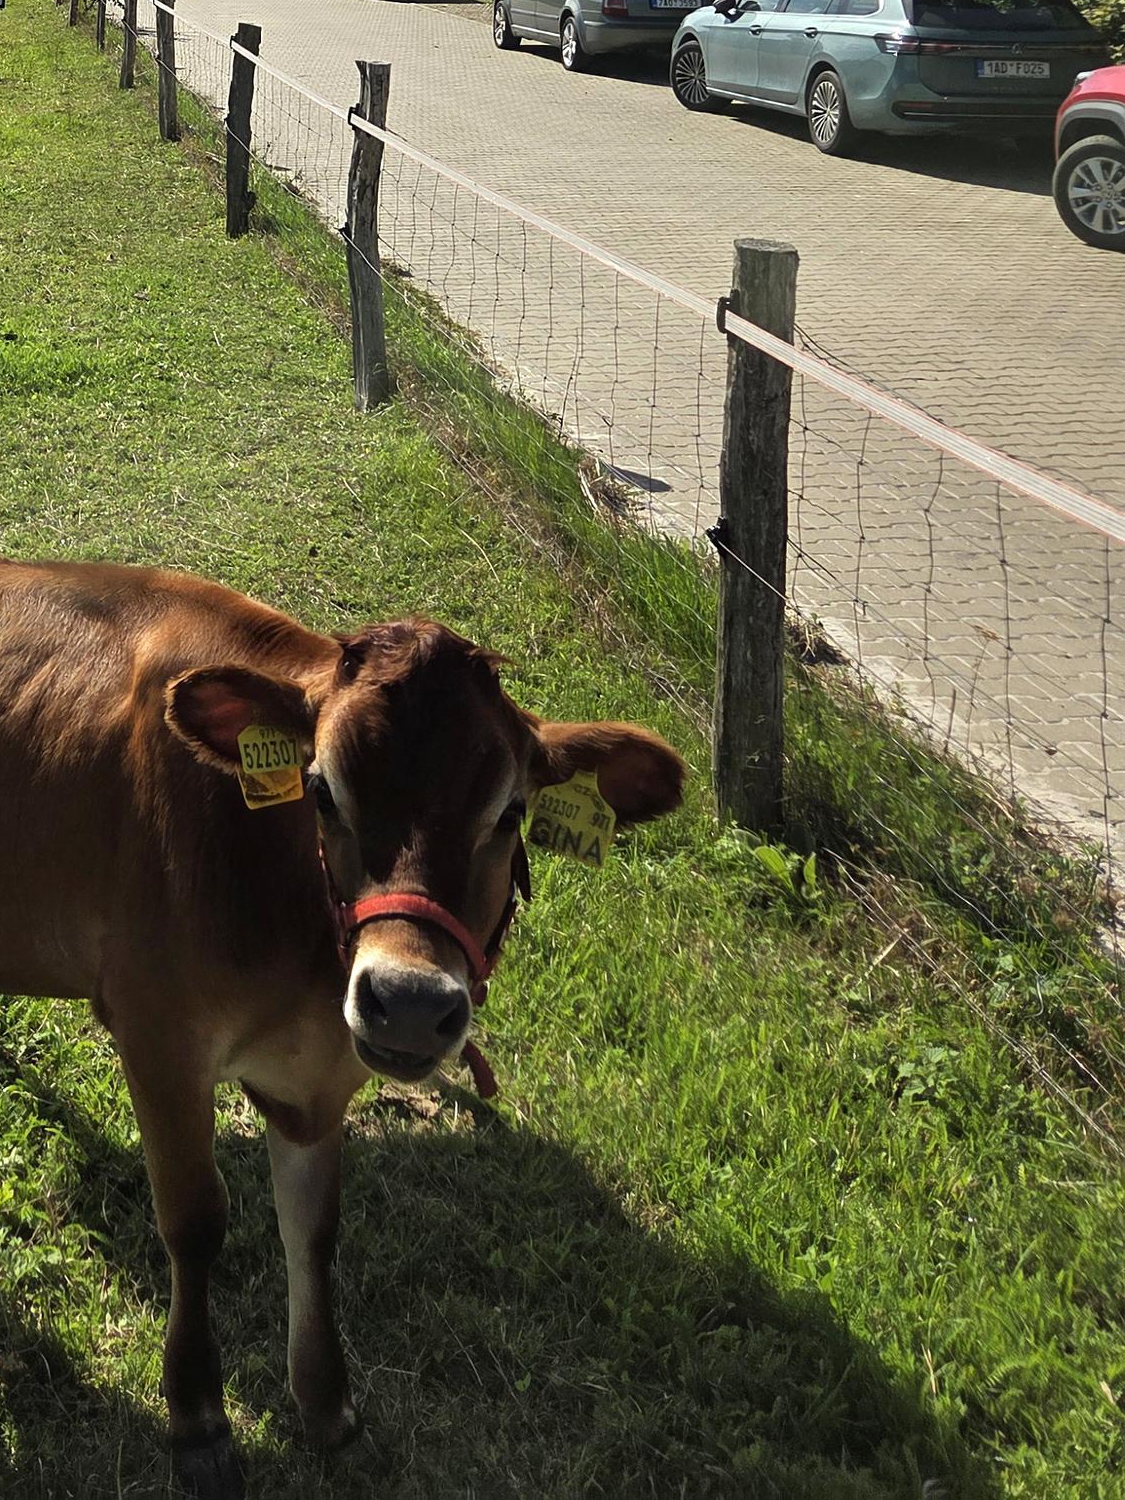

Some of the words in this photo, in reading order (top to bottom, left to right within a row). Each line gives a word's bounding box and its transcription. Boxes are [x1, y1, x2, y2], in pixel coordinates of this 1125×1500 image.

[988, 63, 1008, 73] 1AD
[1016, 63, 1045, 73] F025
[243, 740, 297, 769] 522307
[540, 795, 580, 820] 522307
